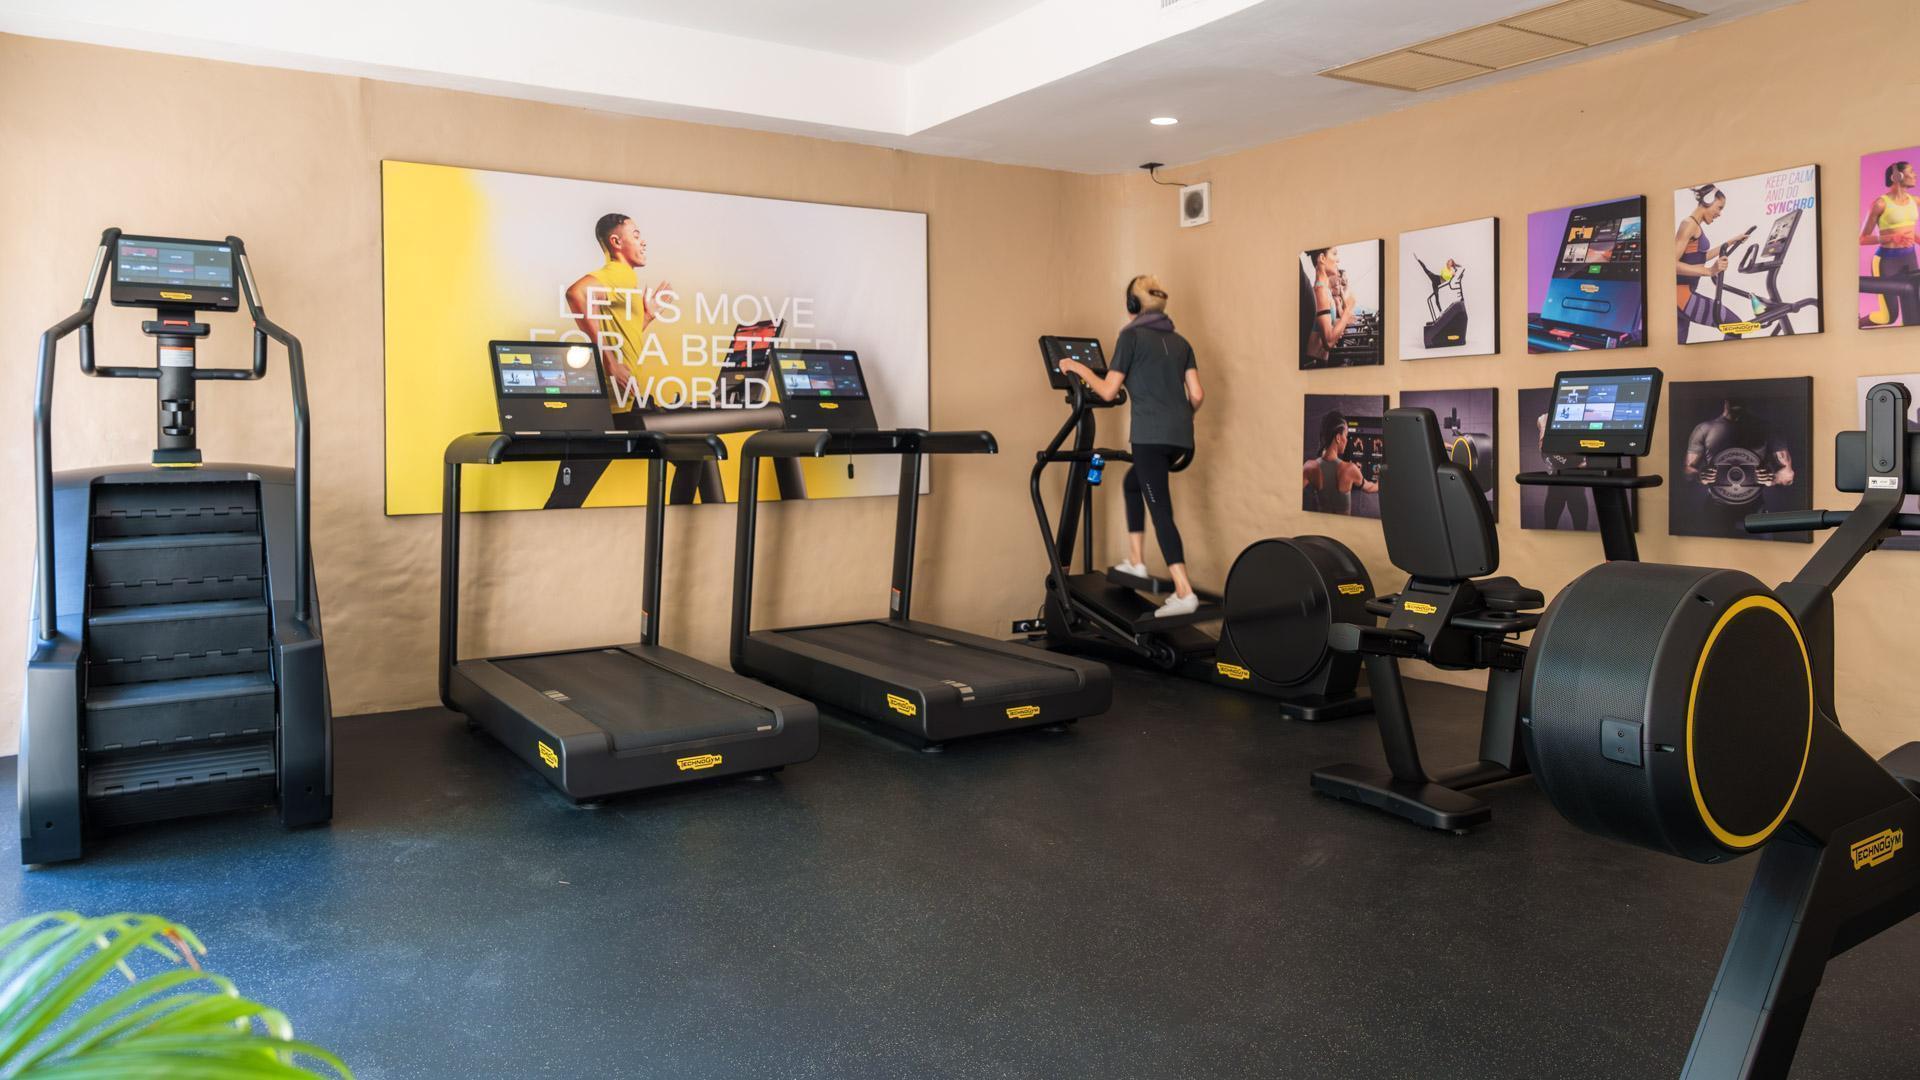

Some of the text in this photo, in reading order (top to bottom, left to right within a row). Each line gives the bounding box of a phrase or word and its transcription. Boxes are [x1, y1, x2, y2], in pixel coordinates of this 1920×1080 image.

[1766, 168, 1814, 188] KEEP CALM
[1766, 185, 1799, 201] AND DO
[1766, 196, 1815, 215] SYNCHRO
[559, 284, 815, 328] LET'S MOVE
[636, 333, 669, 366] A
[609, 375, 771, 410] WORLD
[678, 756, 721, 768] TECHNOGYM
[1852, 832, 1902, 865] TECHNOGYM
